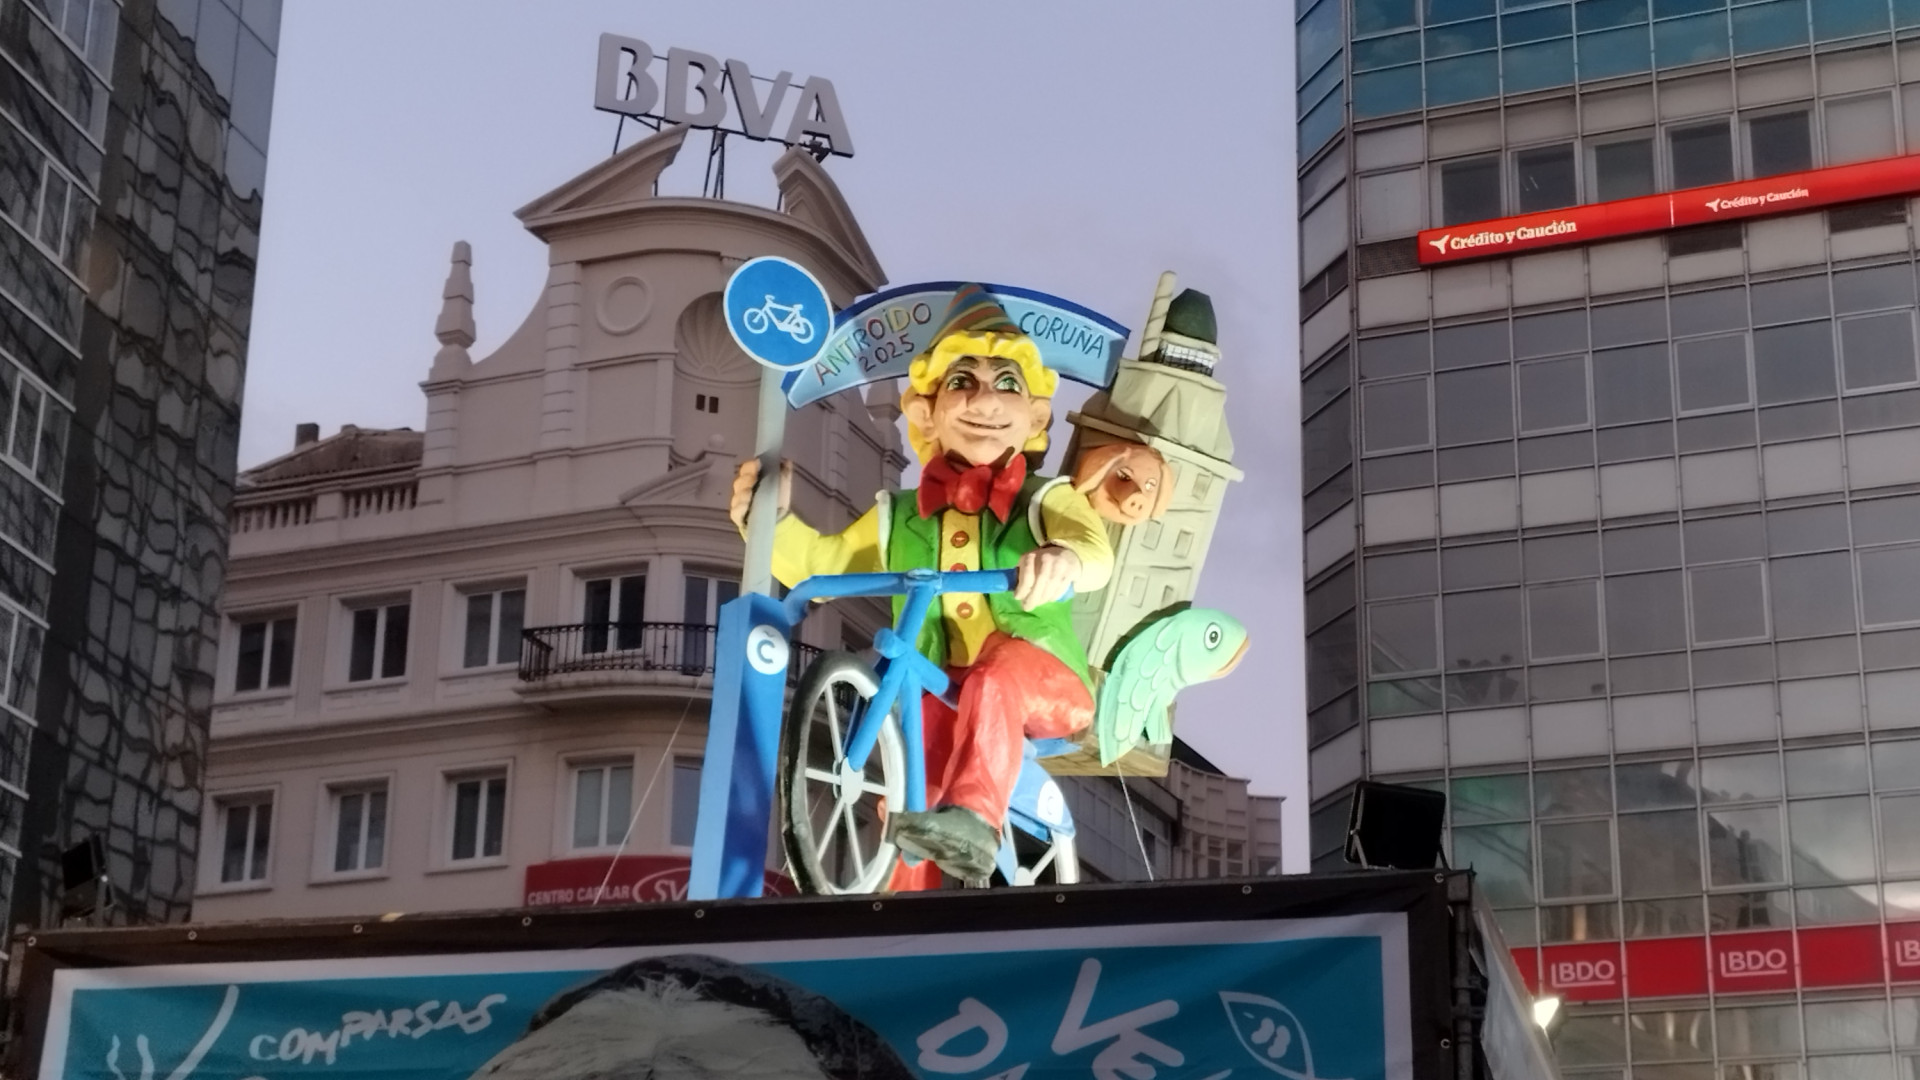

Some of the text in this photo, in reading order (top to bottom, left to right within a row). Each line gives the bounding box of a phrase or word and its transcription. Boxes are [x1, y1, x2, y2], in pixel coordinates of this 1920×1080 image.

[594, 32, 854, 158] BBVA
[1720, 186, 1809, 210] Crédito y Caución
[1450, 220, 1577, 250] Crédito y Caución
[1019, 311, 1105, 358] CORUÑA
[859, 333, 914, 372] 2025
[527, 885, 630, 906] CENTRO CAPILAR
[1558, 959, 1616, 982] BDO
[1727, 948, 1787, 972] BDO
[248, 993, 507, 1065] COMPARSAS
